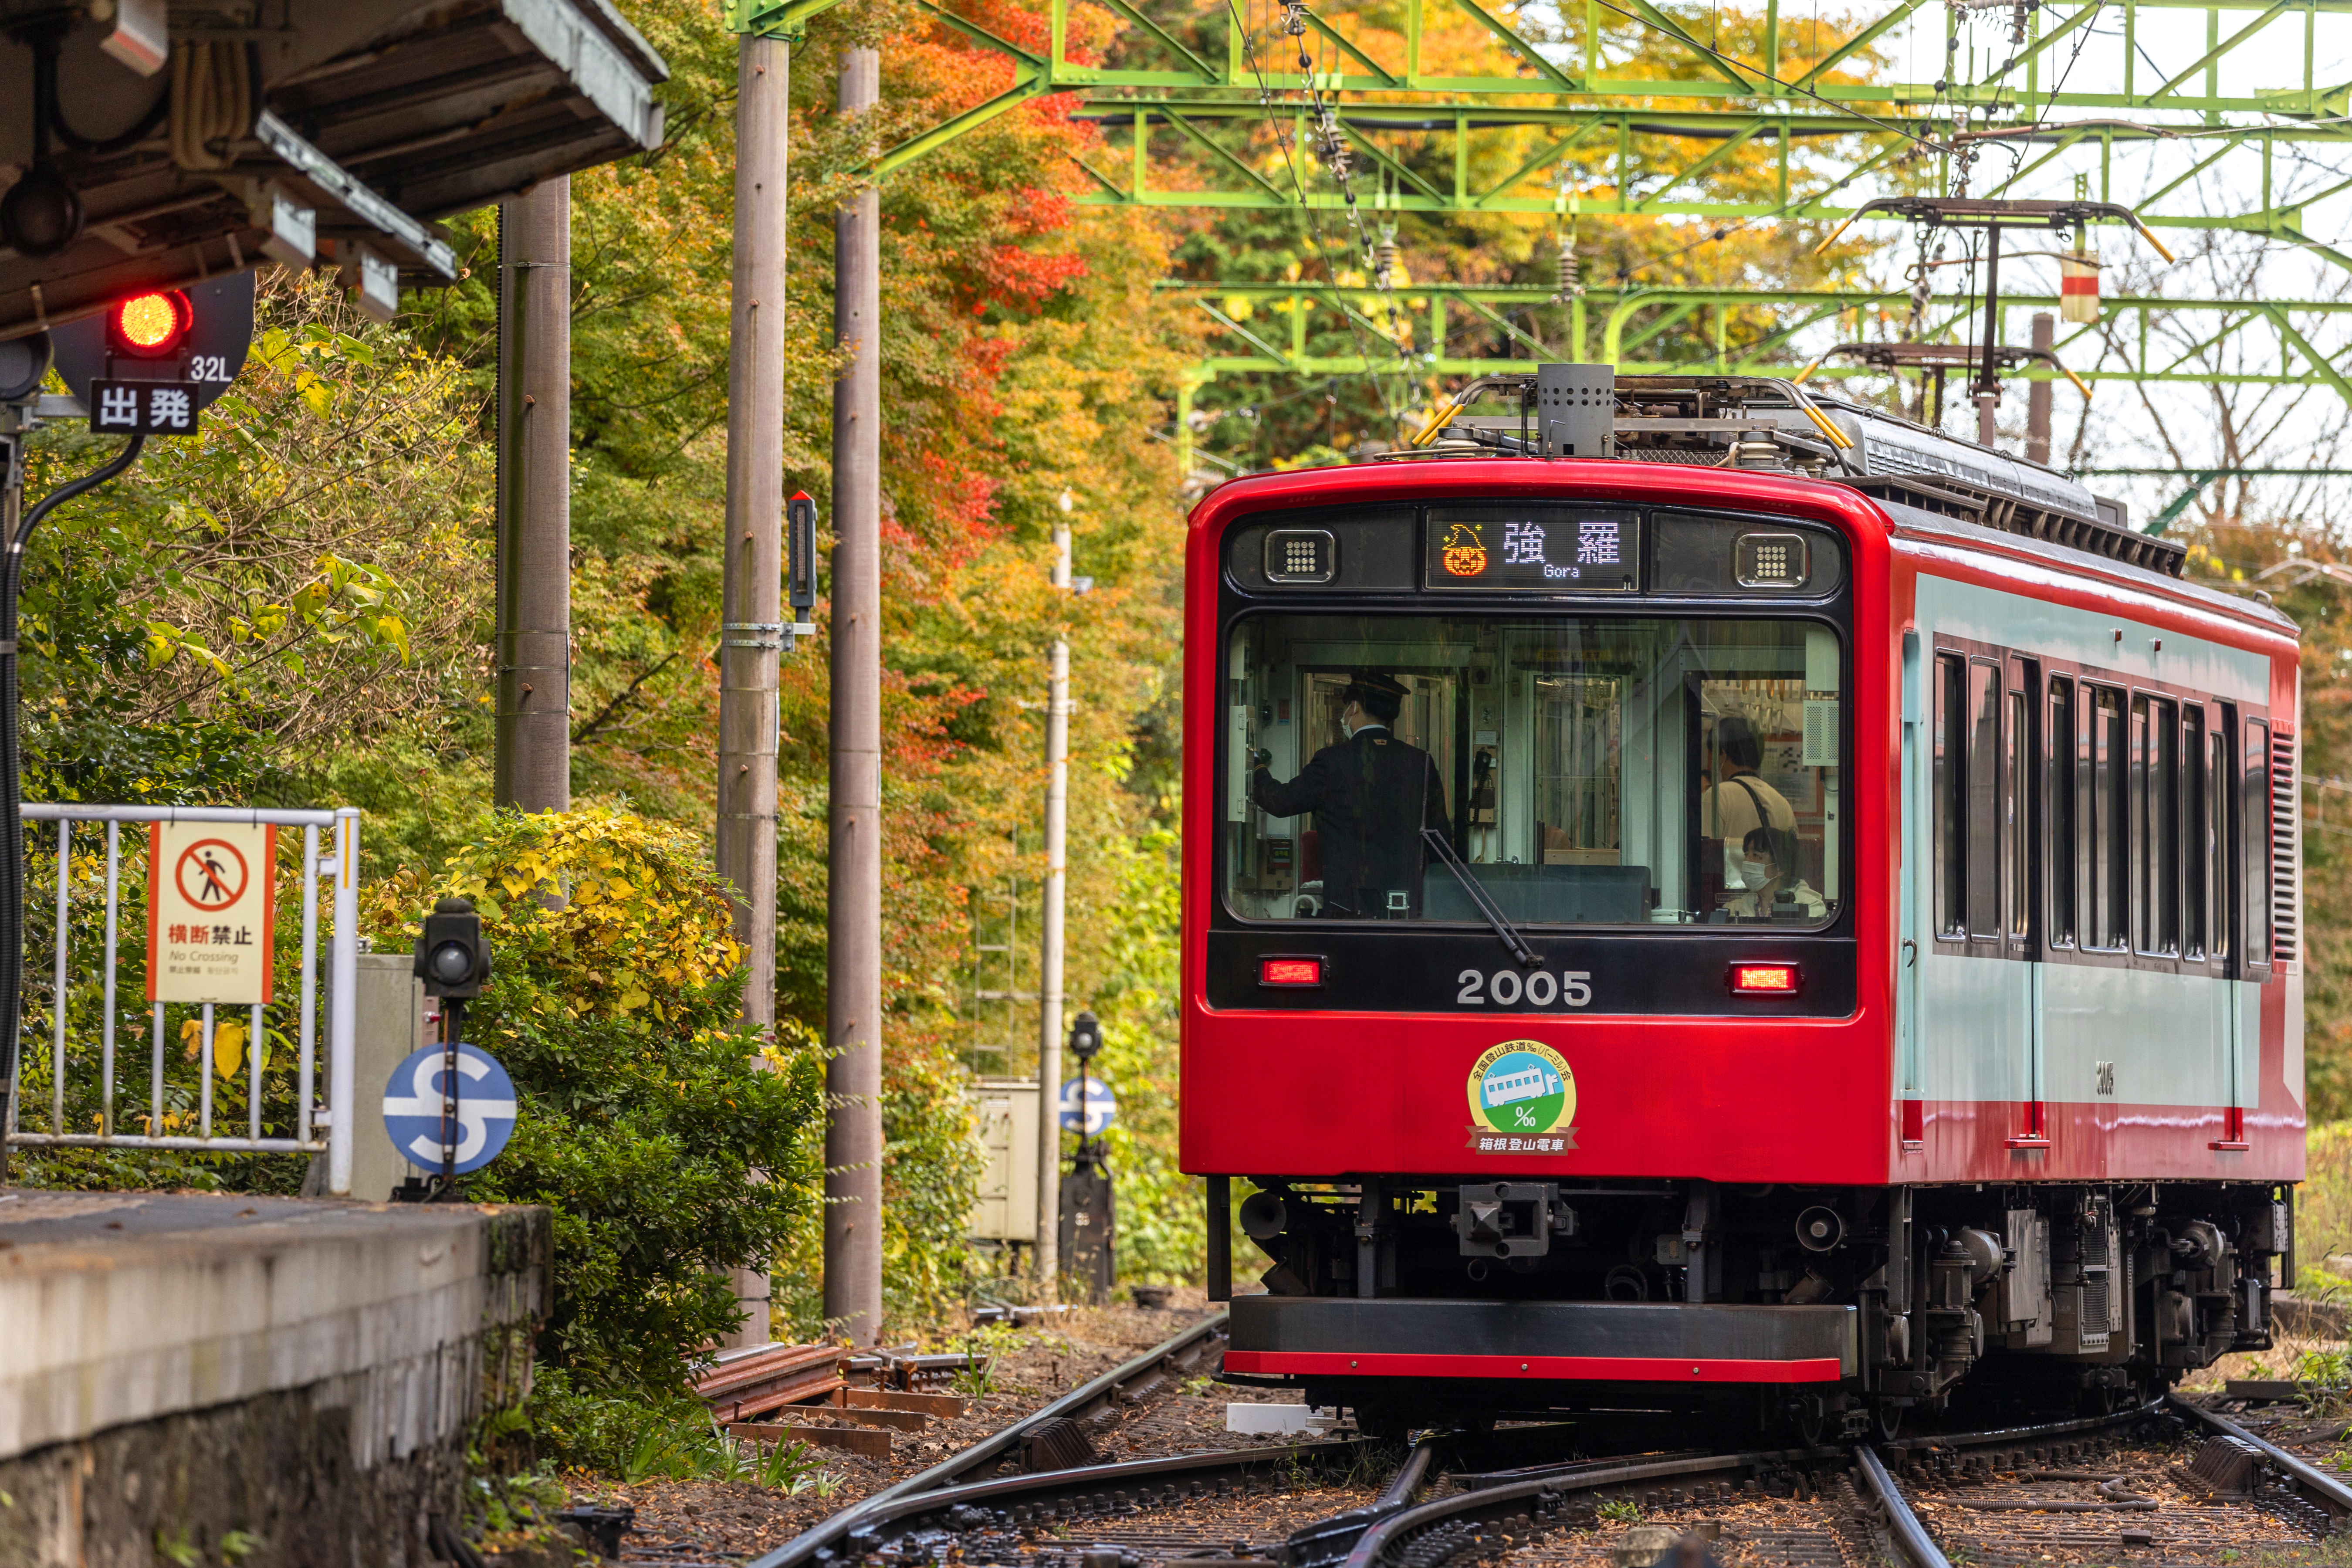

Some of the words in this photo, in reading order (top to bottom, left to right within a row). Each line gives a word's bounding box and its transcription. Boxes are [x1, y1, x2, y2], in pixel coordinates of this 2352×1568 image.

[190, 356, 233, 382] 32L
[100, 386, 190, 427] 出発
[1504, 521, 1620, 563] 強羅
[1543, 564, 1580, 578] Gora
[169, 924, 252, 945] 横断禁止
[169, 951, 186, 961] No
[190, 950, 239, 965] Crossing
[1457, 969, 1592, 1007] 2005
[1479, 1137, 1565, 1151] 箱根登山電車
